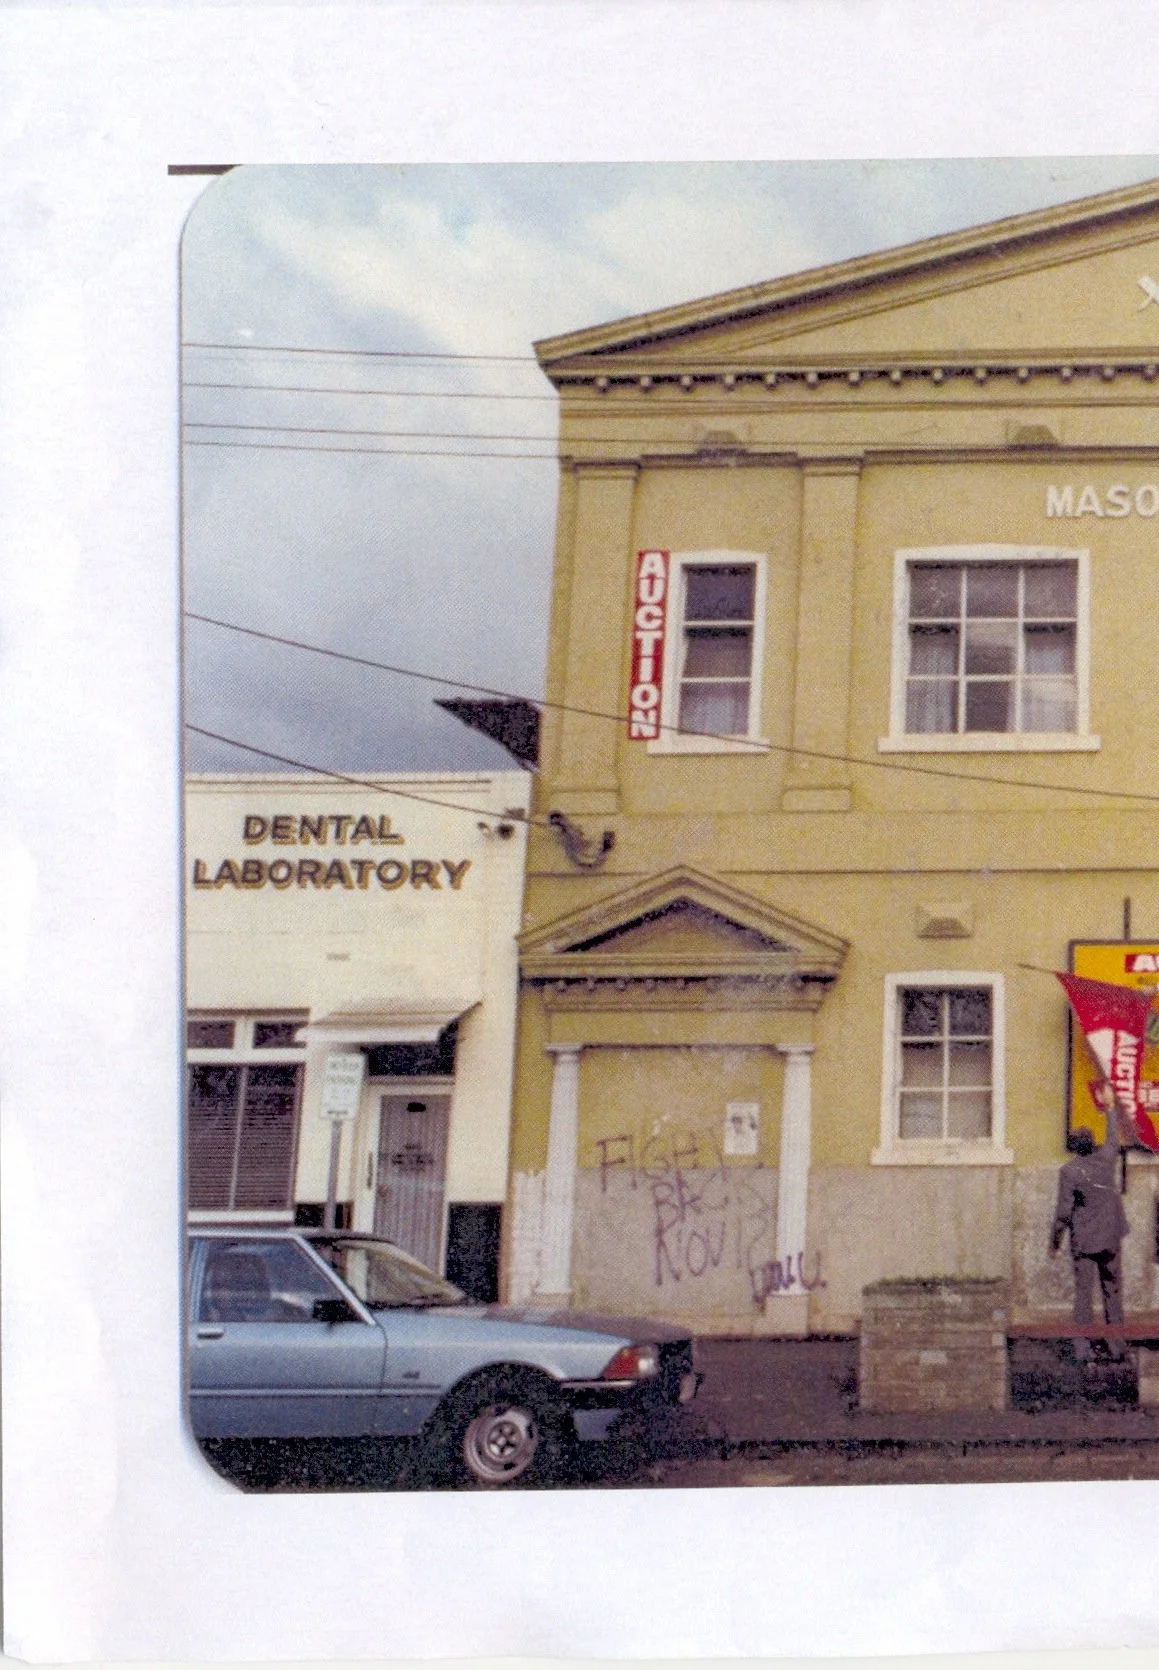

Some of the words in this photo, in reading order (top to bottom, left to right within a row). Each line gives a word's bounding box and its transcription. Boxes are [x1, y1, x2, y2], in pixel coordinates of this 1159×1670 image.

[630, 552, 667, 738] AUCTION
[243, 814, 405, 846] DENTAL
[192, 858, 472, 891] LABORATORY
[1114, 1028, 1141, 1120] AUCTIO
